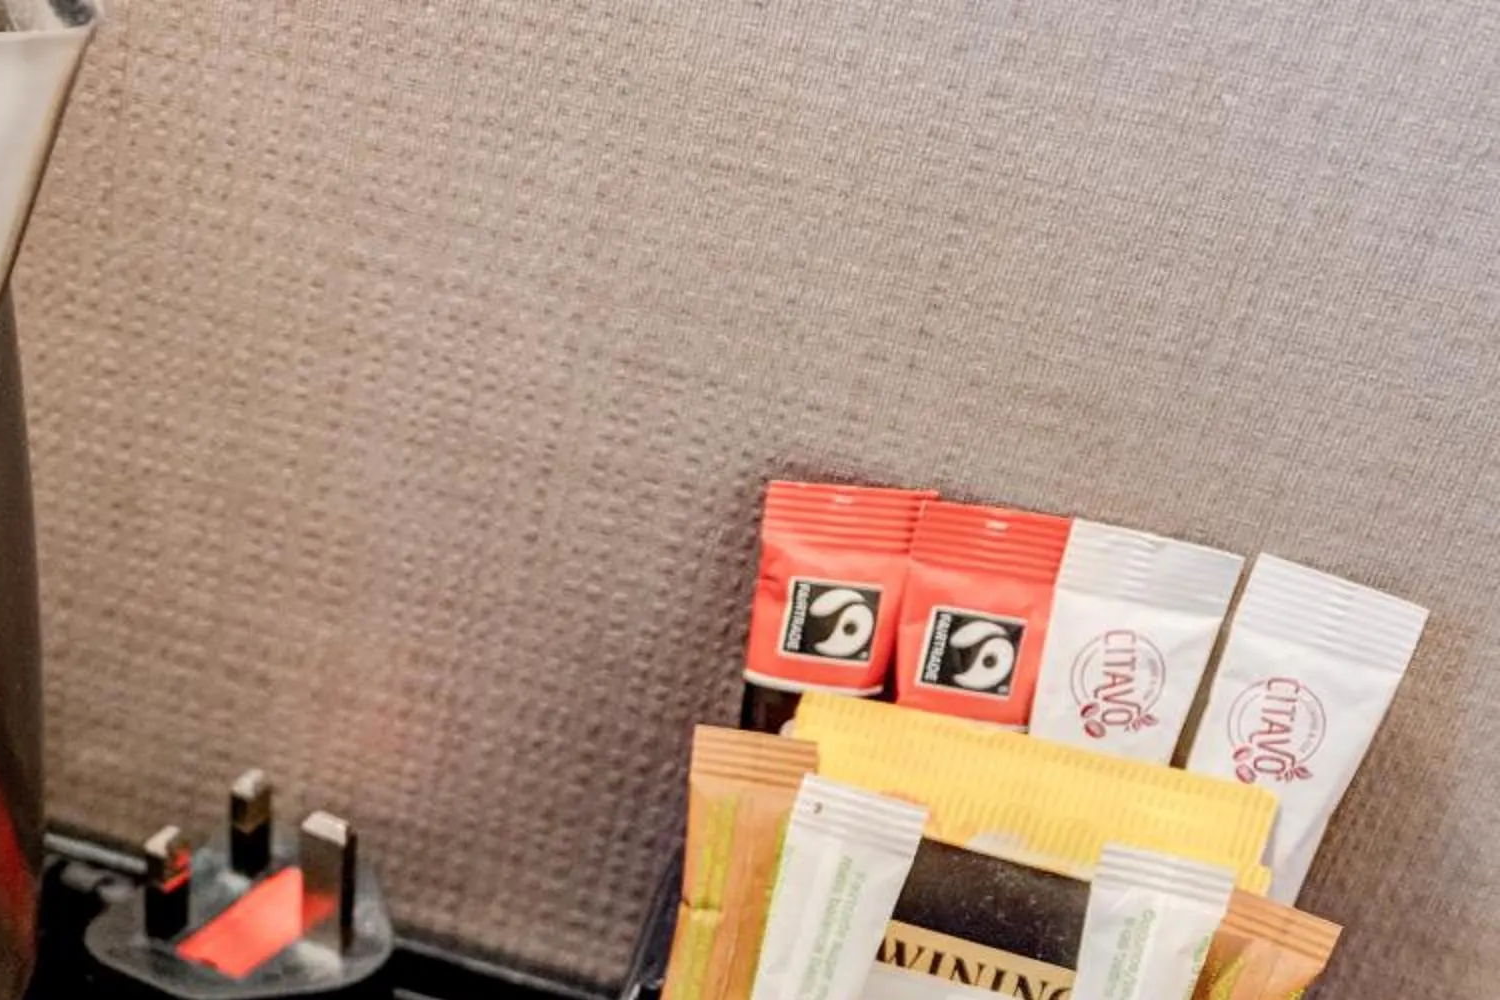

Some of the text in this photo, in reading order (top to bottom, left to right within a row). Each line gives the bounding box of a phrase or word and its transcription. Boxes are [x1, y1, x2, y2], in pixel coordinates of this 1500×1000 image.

[787, 582, 811, 650] FAIRTRADE
[924, 611, 952, 682] FAIRTRADE
[1094, 629, 1142, 726] CITAVO
[1249, 676, 1300, 775] CITAVO
